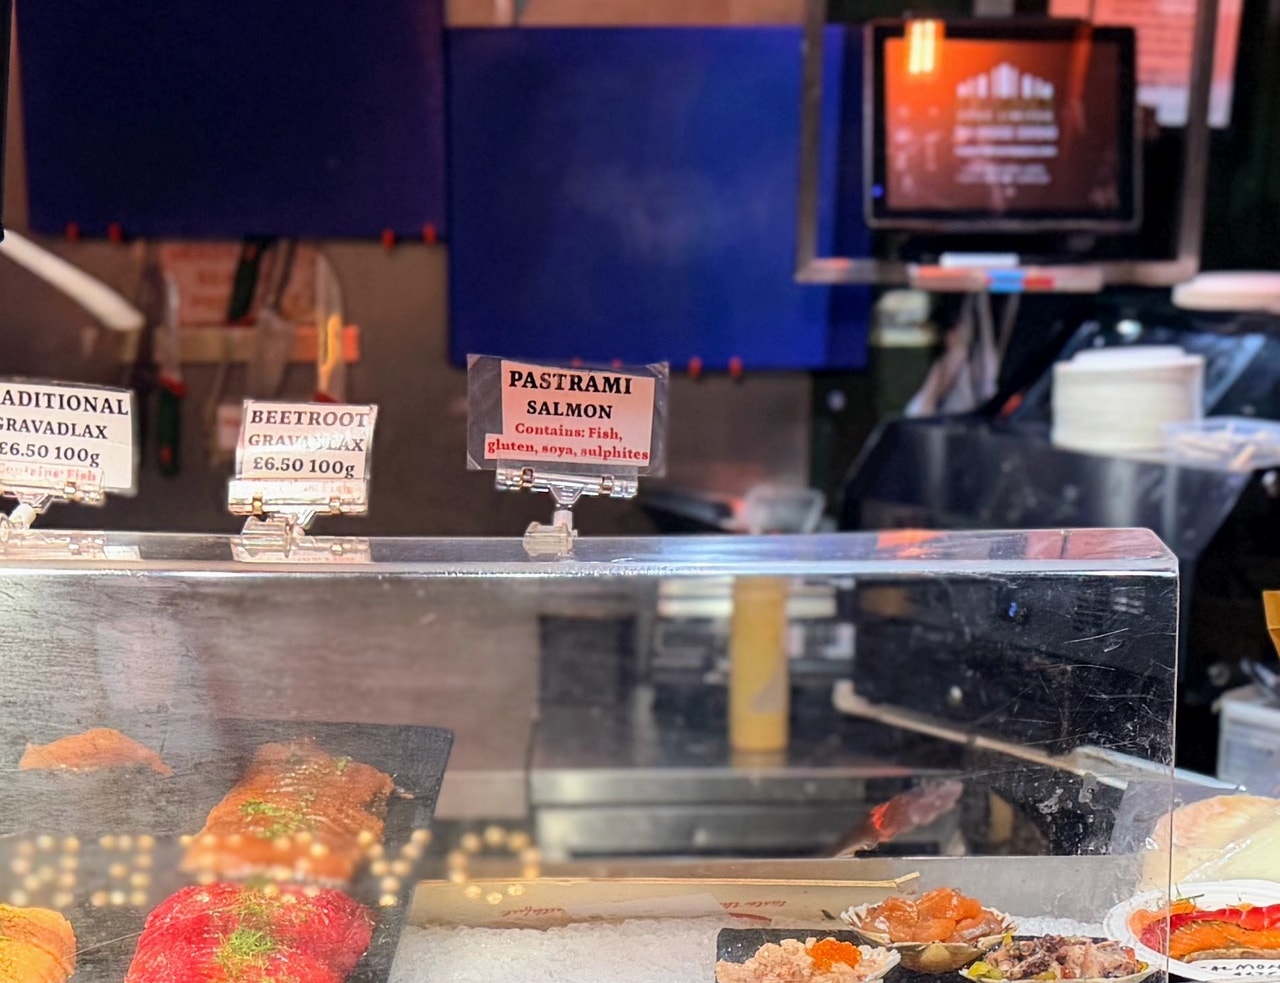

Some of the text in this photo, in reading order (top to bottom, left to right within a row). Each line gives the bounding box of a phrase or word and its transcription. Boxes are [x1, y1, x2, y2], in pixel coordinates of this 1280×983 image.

[508, 370, 632, 395] PASTRAMI
[250, 410, 370, 428] BEETROOT
[526, 400, 613, 419] SALMON
[515, 423, 623, 442] Contains: Fish,
[54, 446, 101, 467] 100g
[487, 438, 649, 461] gluten, soya, sulphites
[253, 457, 355, 479] £6.50 100g
